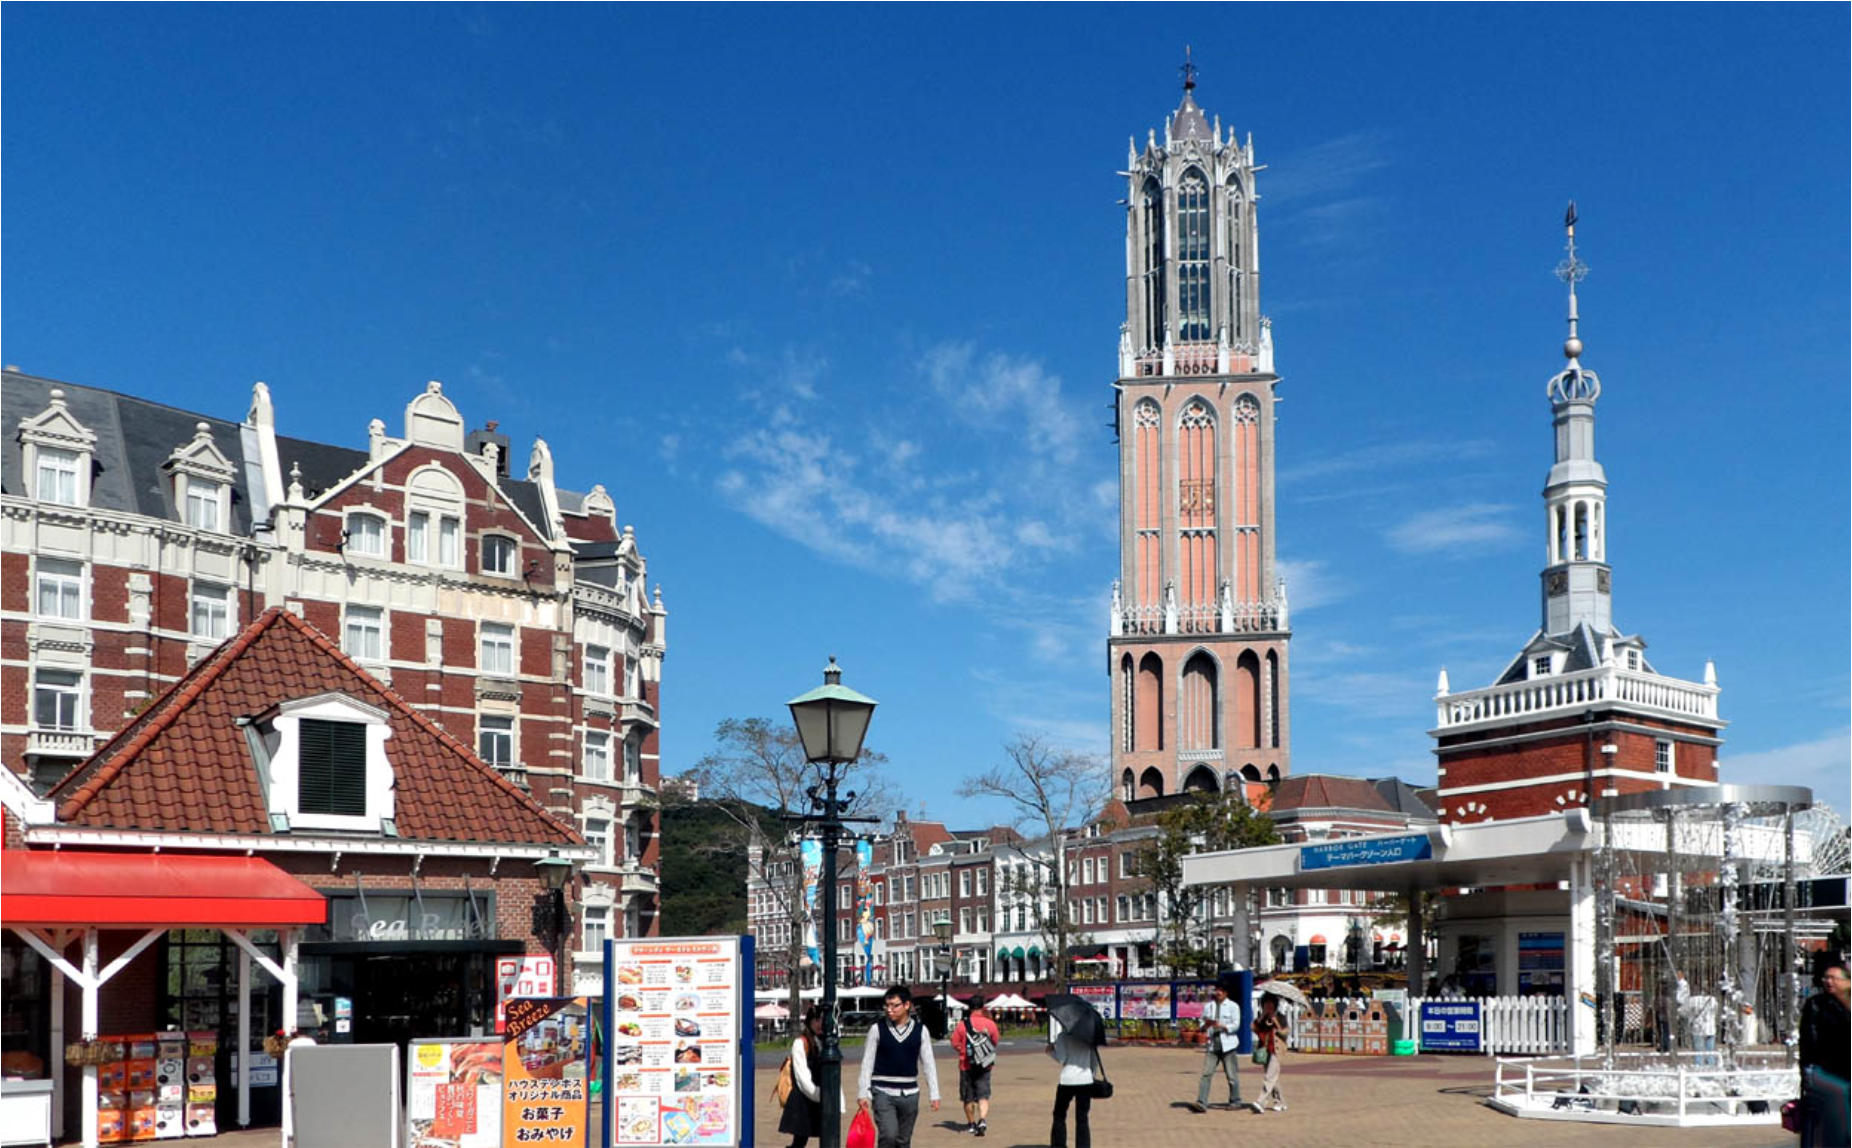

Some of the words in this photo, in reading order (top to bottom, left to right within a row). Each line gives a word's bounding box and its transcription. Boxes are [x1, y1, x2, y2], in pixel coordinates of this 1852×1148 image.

[1314, 843, 1344, 853] HARBOR
[1348, 841, 1367, 850] GATE
[1326, 847, 1402, 862] テーマパークゾーン入口
[508, 1000, 533, 1020] Sea
[506, 1004, 550, 1036] Breeze
[508, 1089, 582, 1101] オリジナル商品
[522, 1106, 565, 1121] お菓子
[516, 1127, 574, 1141] おみやげ
